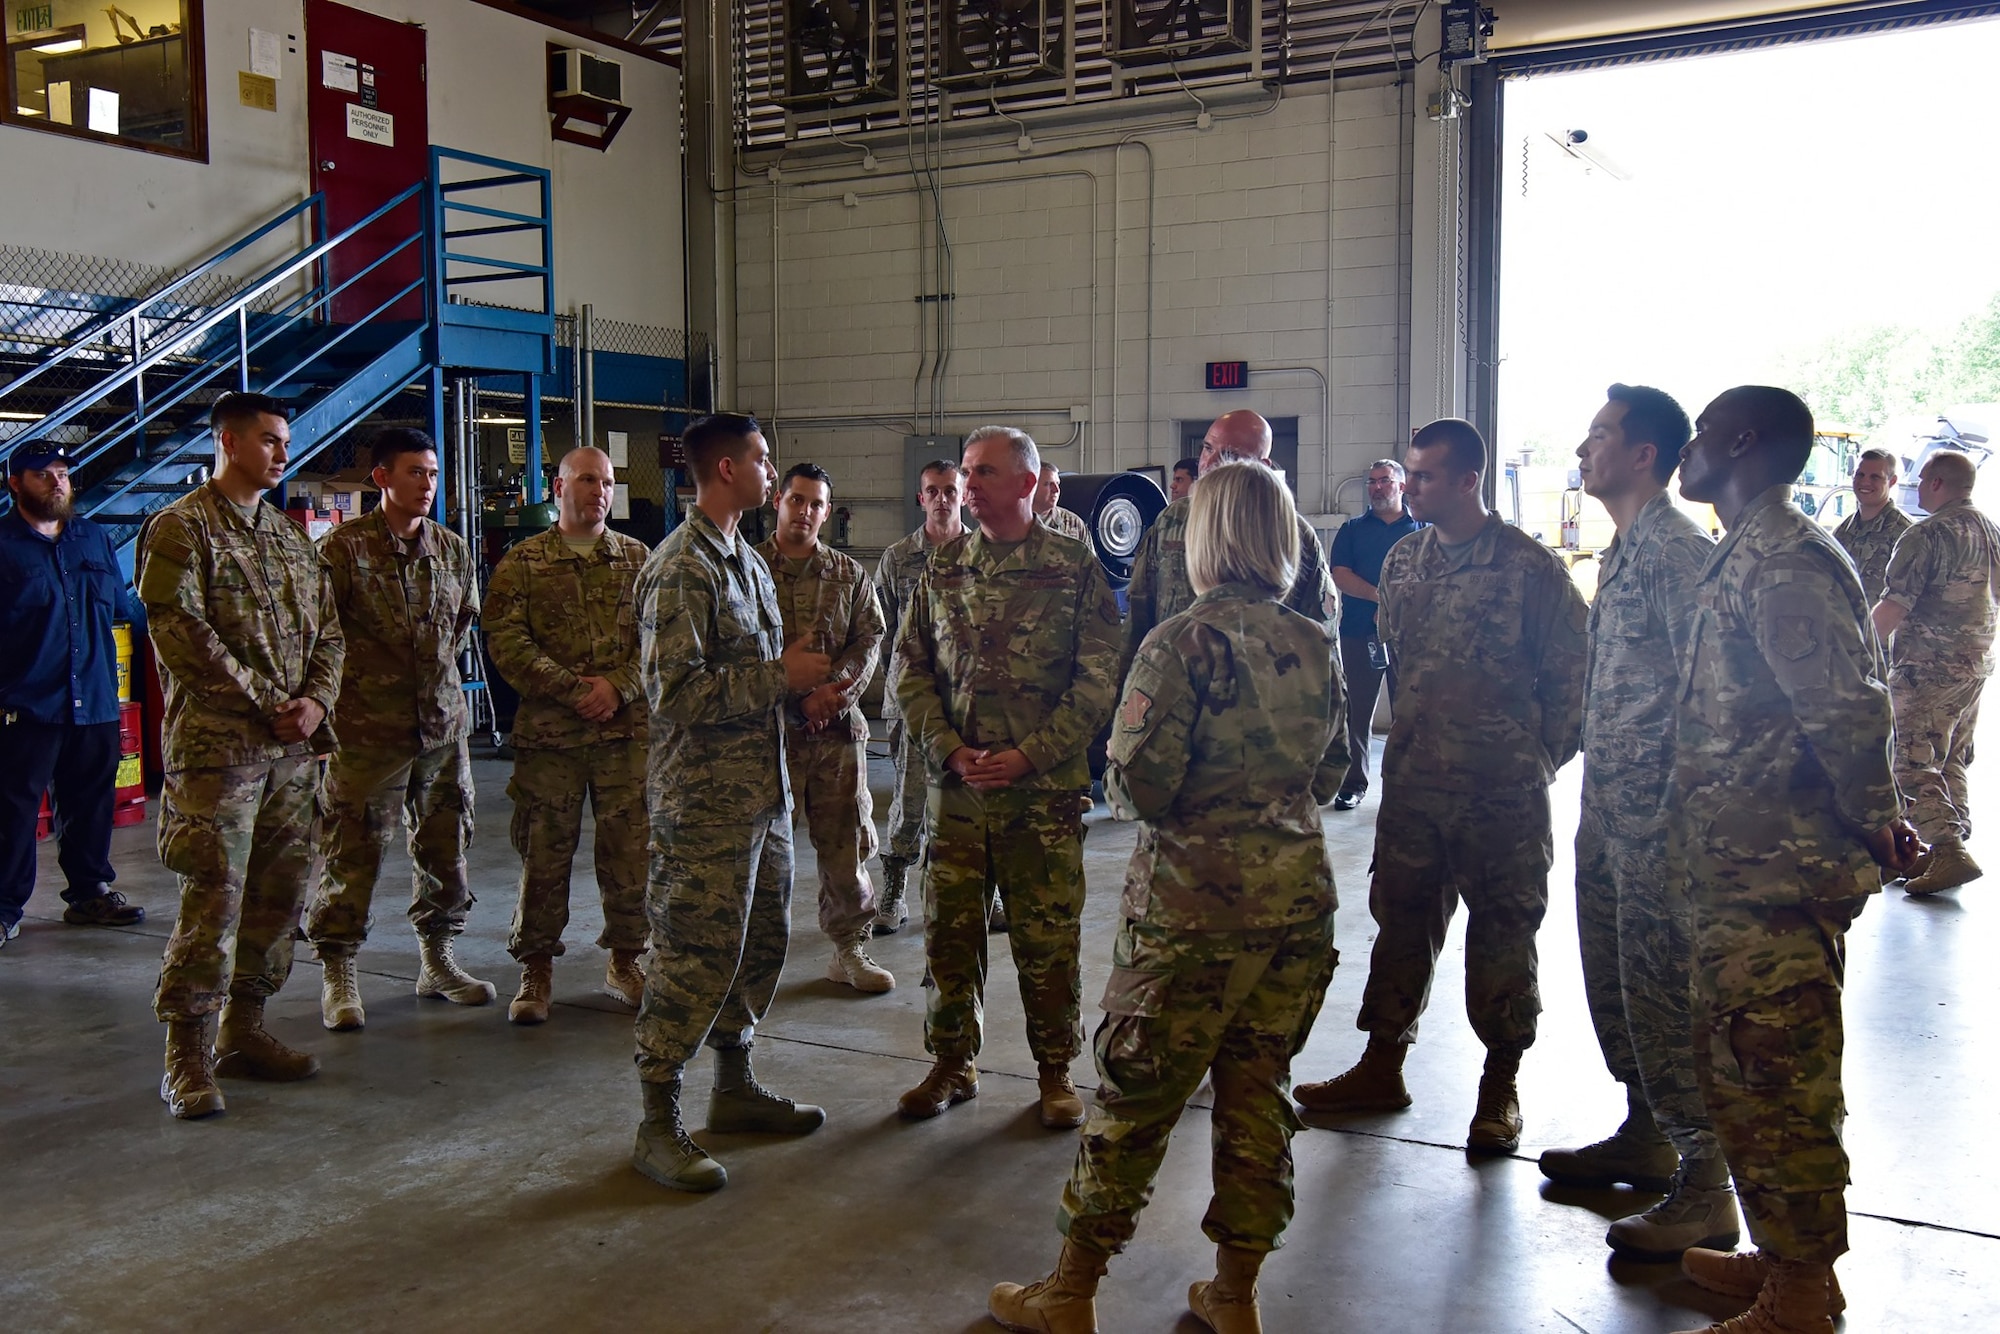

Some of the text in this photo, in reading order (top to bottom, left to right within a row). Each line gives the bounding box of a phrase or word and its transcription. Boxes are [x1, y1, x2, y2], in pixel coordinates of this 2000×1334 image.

[17, 8, 36, 32] EXIT
[351, 109, 390, 125] AUTHORIZED
[352, 118, 389, 134] PERSONNEL
[363, 129, 379, 139] ONLY
[1213, 362, 1240, 386] EXIT
